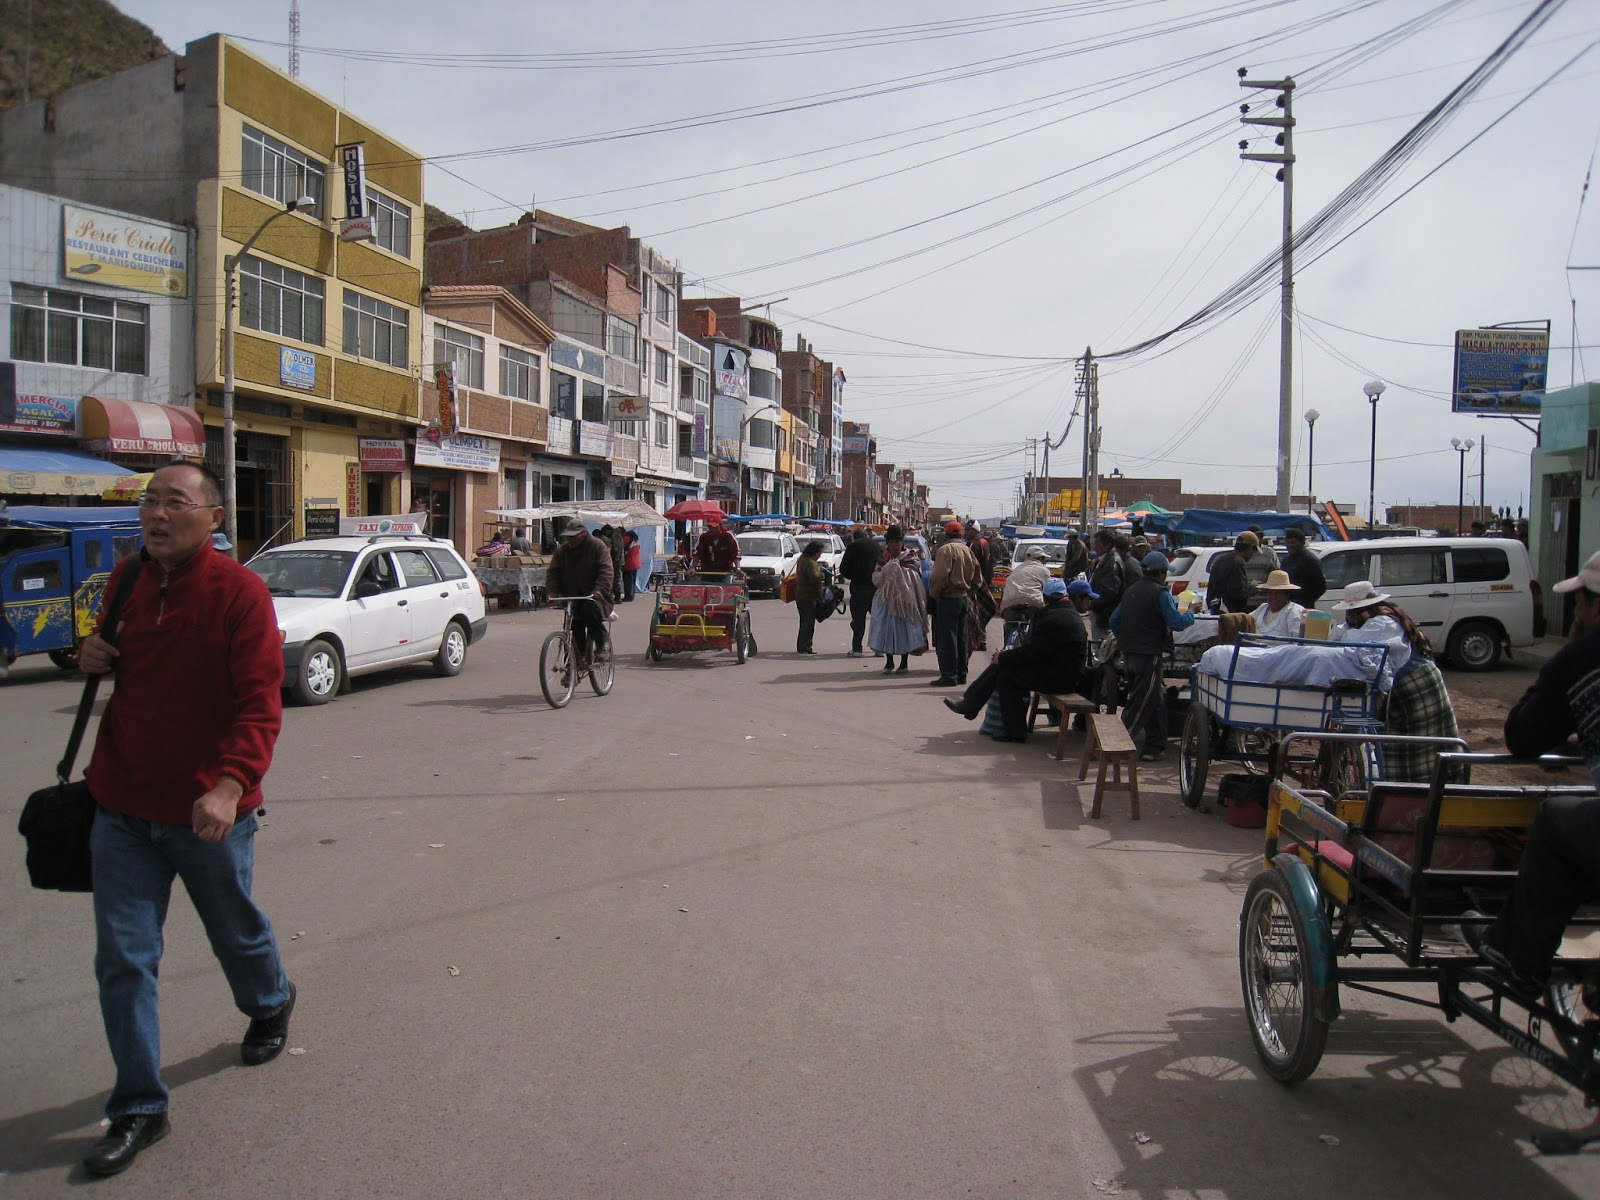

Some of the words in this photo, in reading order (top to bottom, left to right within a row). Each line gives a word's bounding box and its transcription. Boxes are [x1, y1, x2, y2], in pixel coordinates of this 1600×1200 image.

[345, 150, 359, 217] HOSTAL
[66, 239, 129, 259] RESTAURANT
[132, 251, 185, 270] CEBICHERIA
[88, 252, 95, 261] Y
[98, 255, 165, 274] MARISQUERIA
[1463, 341, 1492, 353] MASALA
[1495, 341, 1520, 354] TOURS
[348, 467, 356, 515] INTERNE
[358, 523, 379, 532] TAXI
